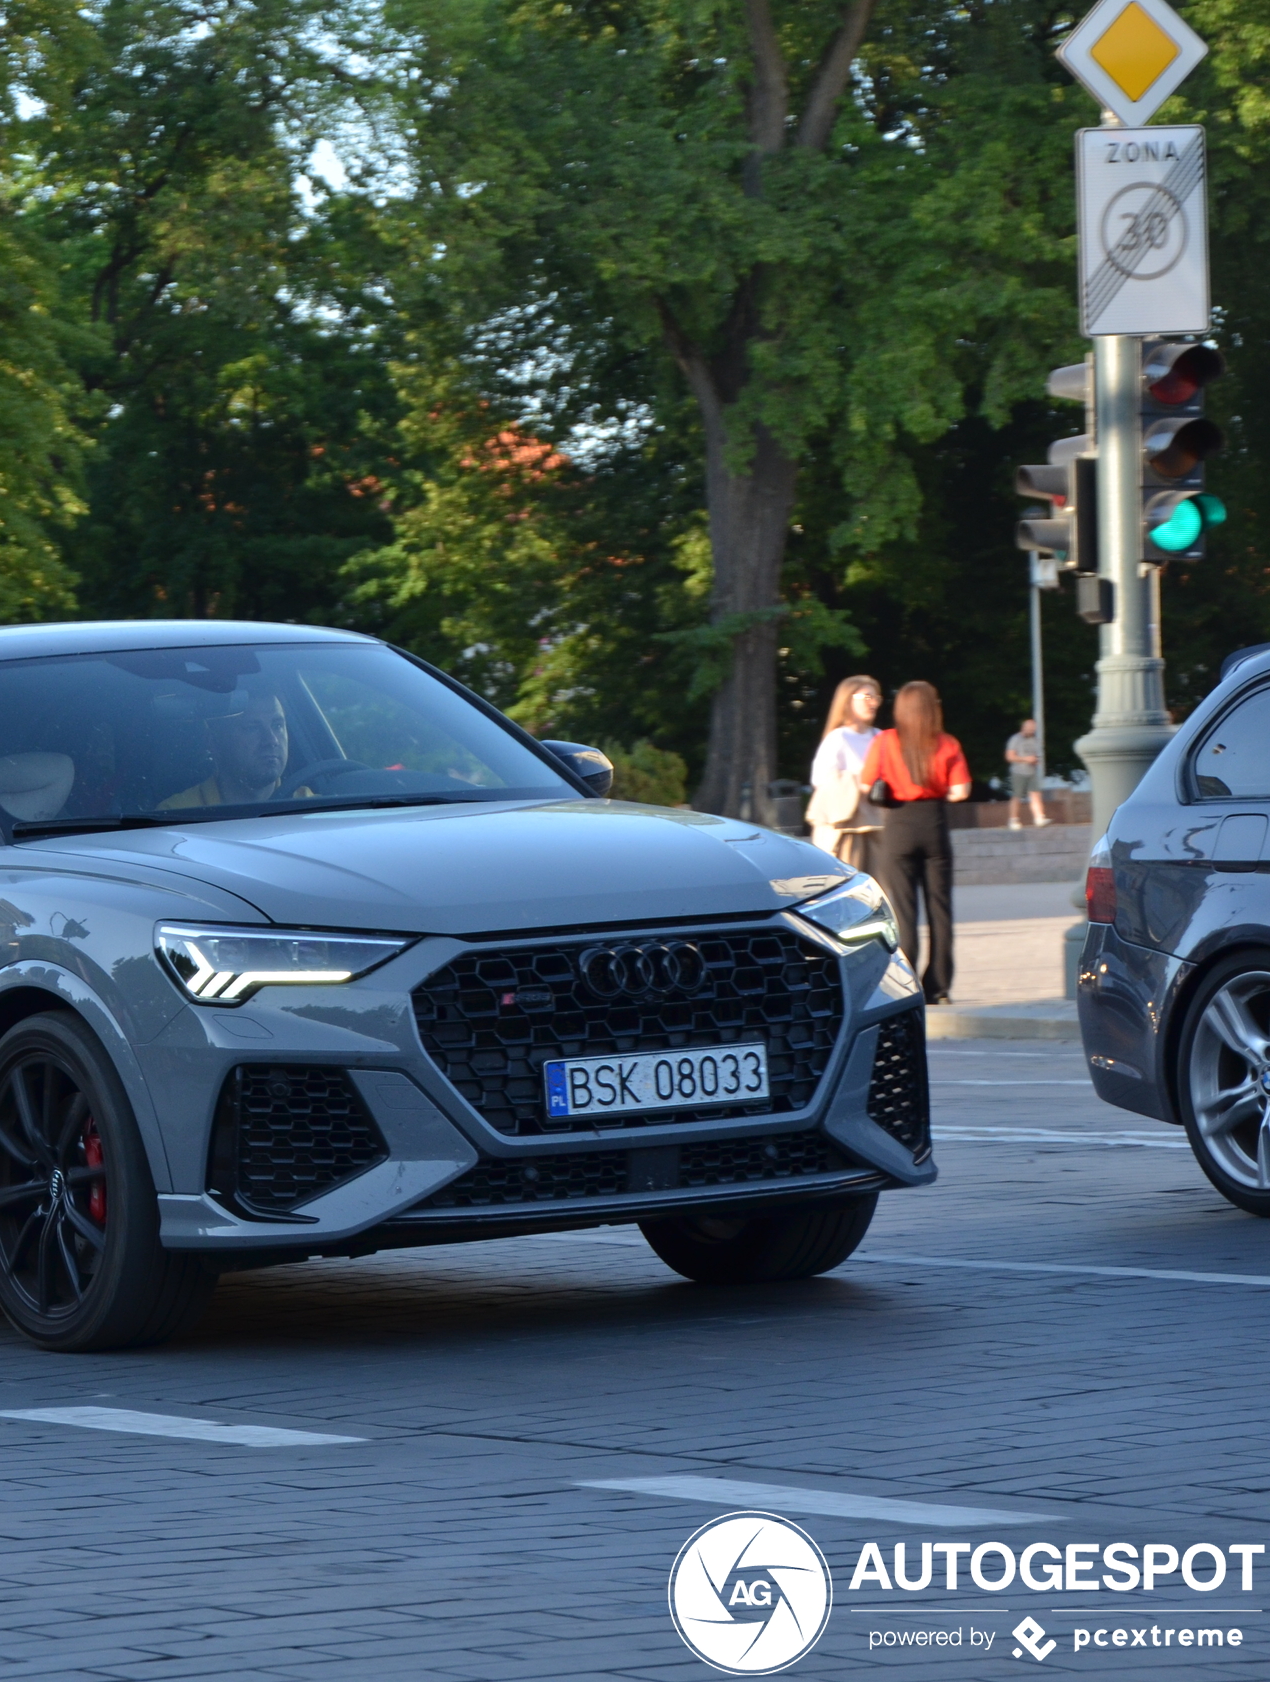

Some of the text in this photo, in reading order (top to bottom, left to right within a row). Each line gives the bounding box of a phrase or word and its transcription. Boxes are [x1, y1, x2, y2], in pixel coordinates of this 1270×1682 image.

[1103, 141, 1180, 164] ZONA
[569, 1050, 763, 1110] BSK 08033
[551, 1095, 567, 1107] PL
